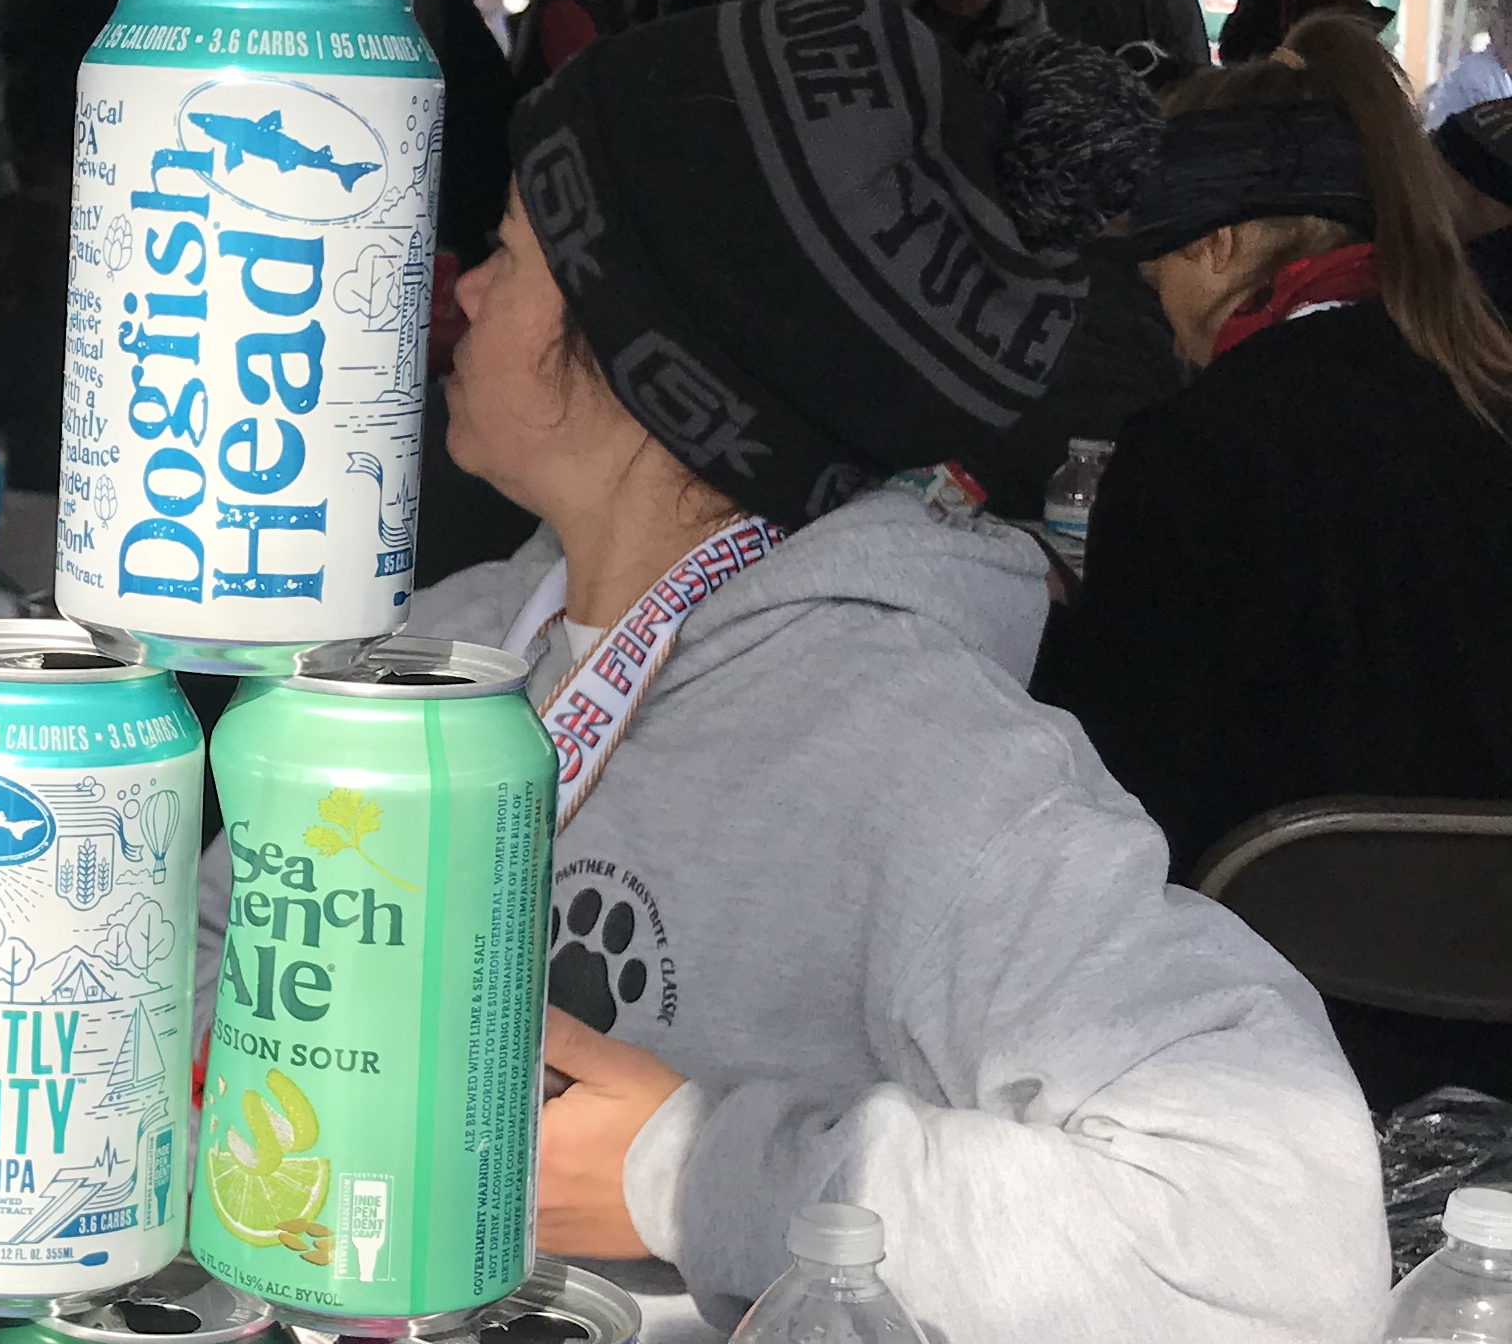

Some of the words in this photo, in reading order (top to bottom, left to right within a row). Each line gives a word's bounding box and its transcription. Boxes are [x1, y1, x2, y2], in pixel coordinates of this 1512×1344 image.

[208, 28, 240, 54] 3.6
[246, 29, 309, 57] CARBS
[331, 33, 355, 59] 95
[117, 147, 215, 604] Dogfish
[211, 229, 329, 604] Head
[6, 725, 88, 751] CALORIES
[110, 726, 137, 750] 3.6
[140, 716, 178, 747] CARBS
[229, 819, 318, 892] Sea
[219, 933, 332, 1022] Ale
[555, 857, 617, 886] PANTHER
[621, 869, 669, 950] FROSTBITE
[657, 957, 678, 1028] CLASSIC
[290, 1043, 382, 1075] SOUR
[100, 1207, 133, 1230] CARBS
